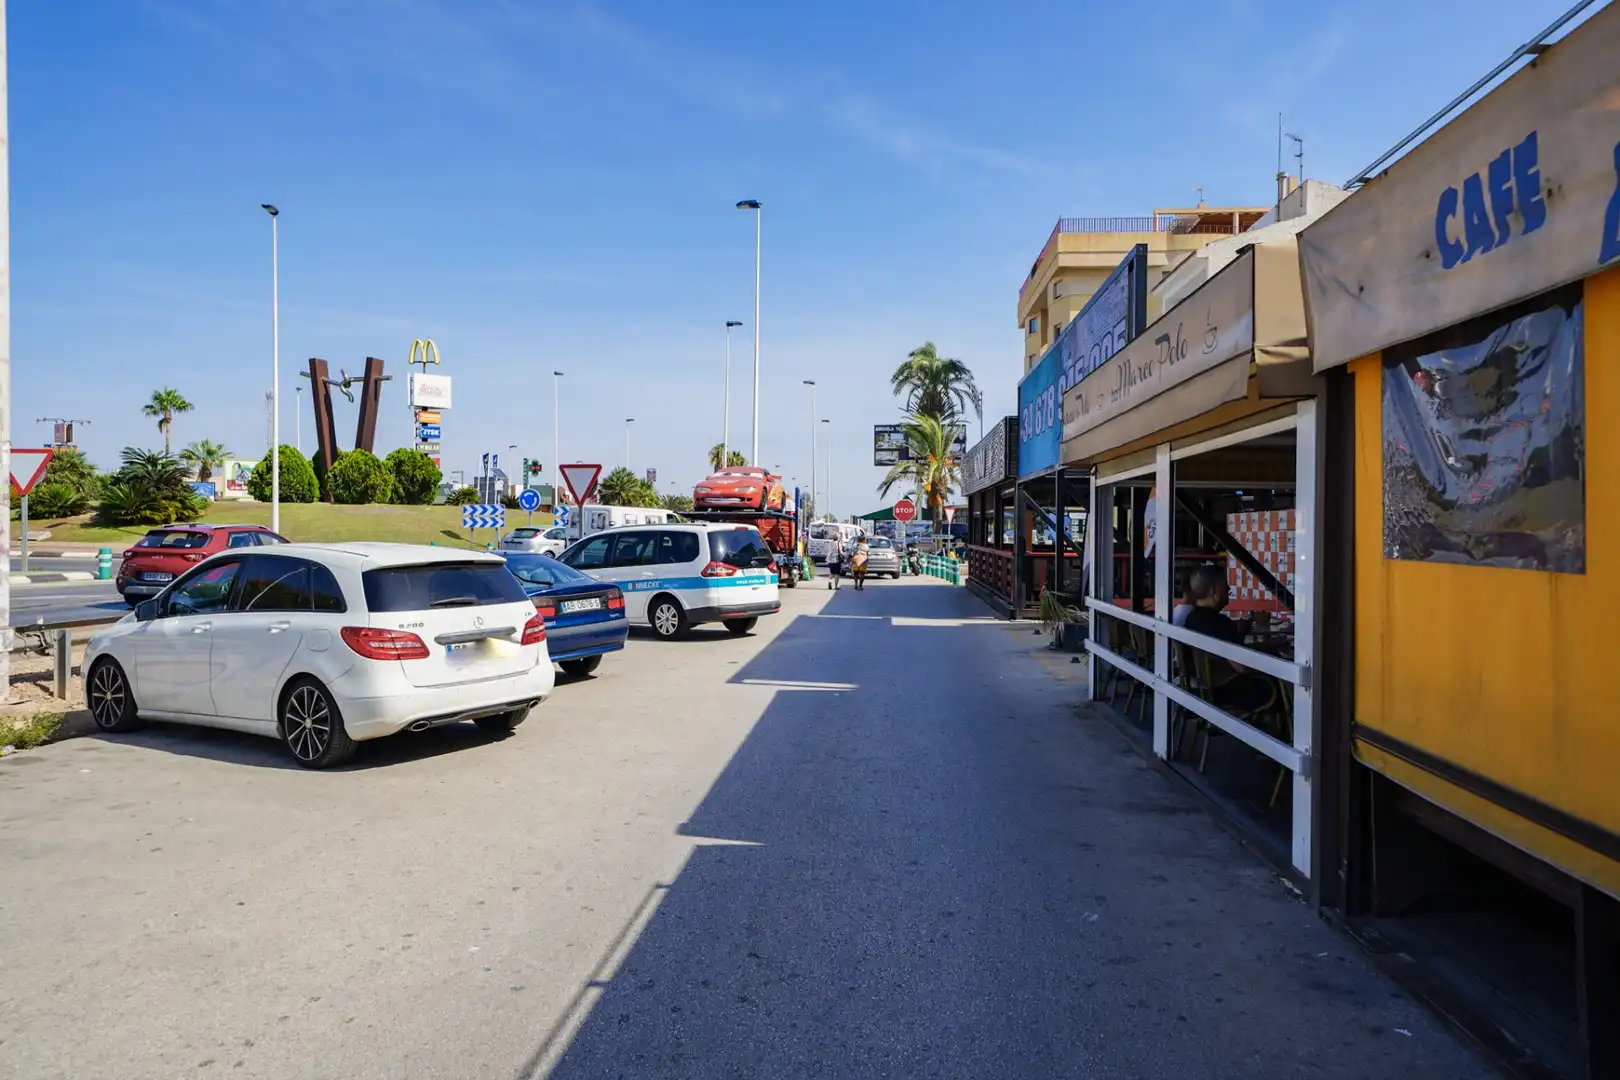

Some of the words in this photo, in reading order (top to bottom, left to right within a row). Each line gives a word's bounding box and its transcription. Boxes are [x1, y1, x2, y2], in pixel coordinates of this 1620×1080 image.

[1435, 130, 1547, 270] CAFE
[1154, 322, 1188, 384] Polo
[424, 428, 440, 436] JYSK
[1035, 384, 1055, 436] 678
[895, 507, 914, 515] STOP
